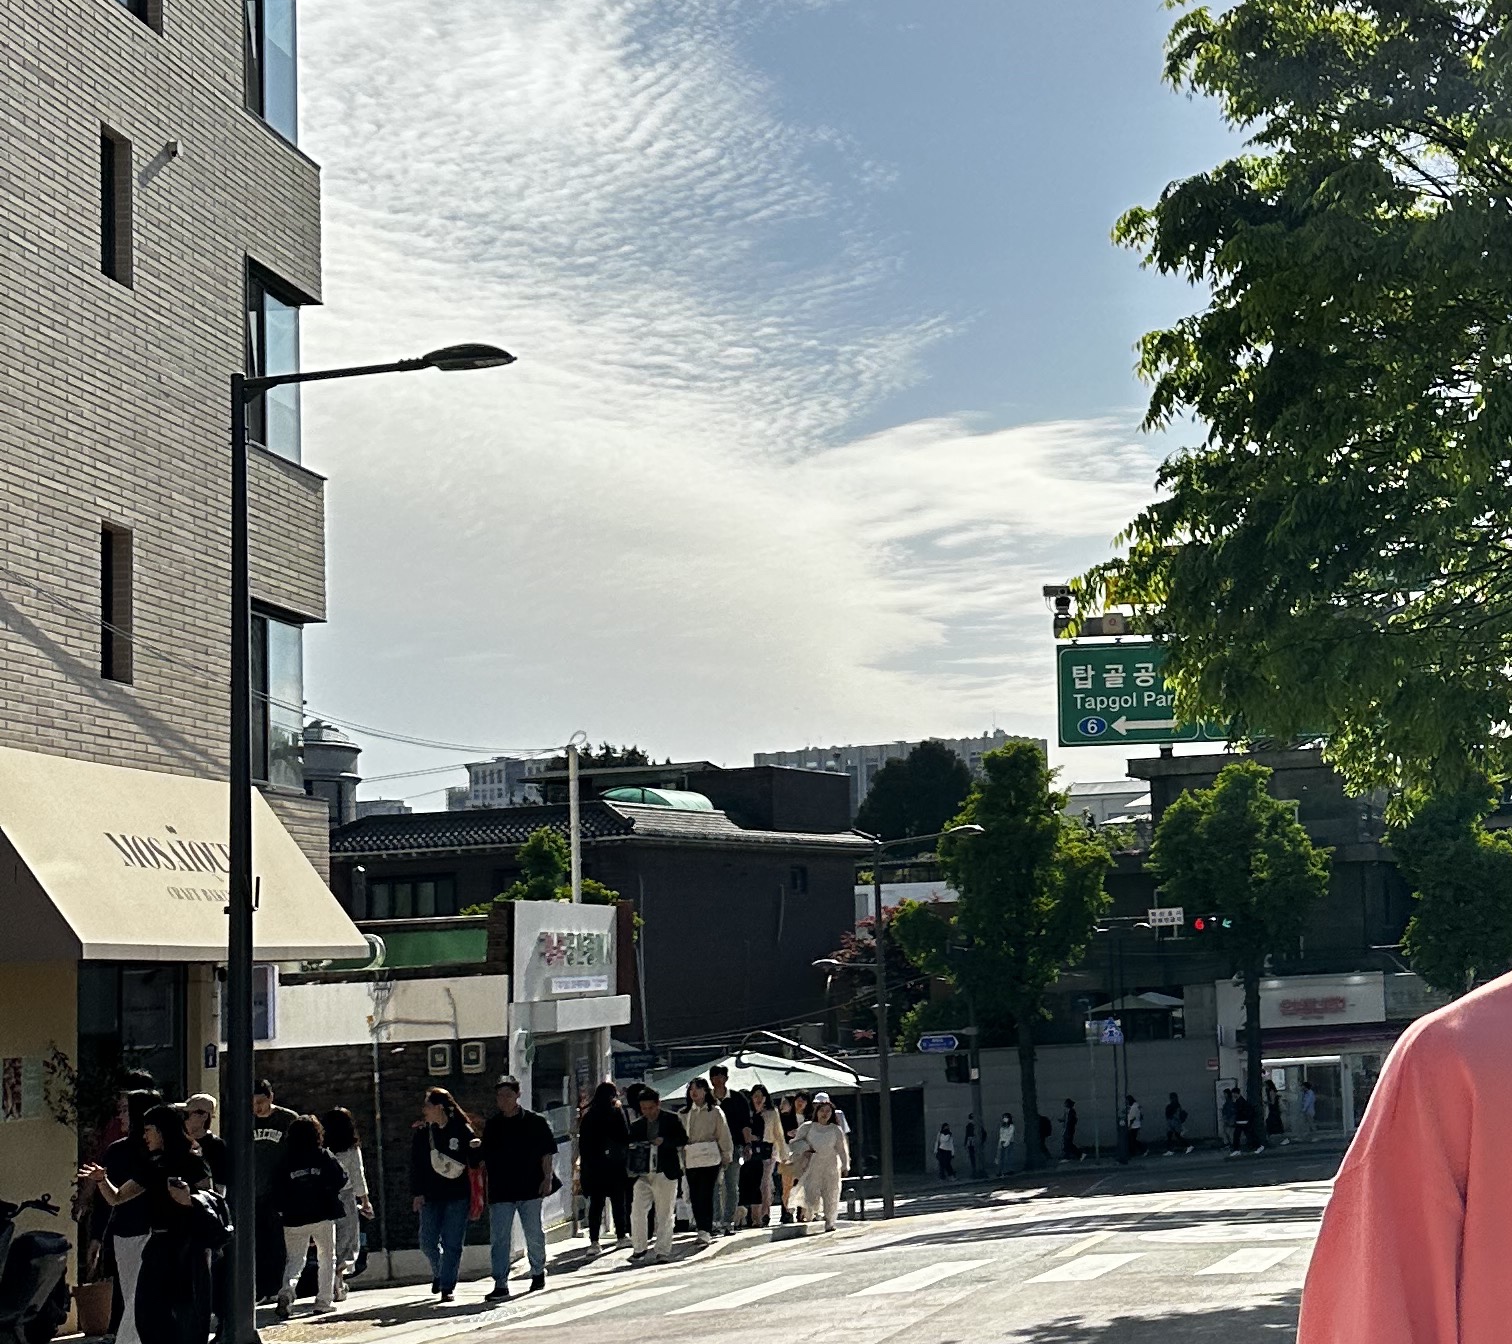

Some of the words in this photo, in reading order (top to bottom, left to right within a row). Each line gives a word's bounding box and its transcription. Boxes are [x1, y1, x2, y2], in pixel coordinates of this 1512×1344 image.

[1072, 662, 1157, 689] 탑골공
[1073, 692, 1137, 712] Tapgol
[1143, 691, 1175, 708] Par
[1087, 719, 1098, 734] 6
